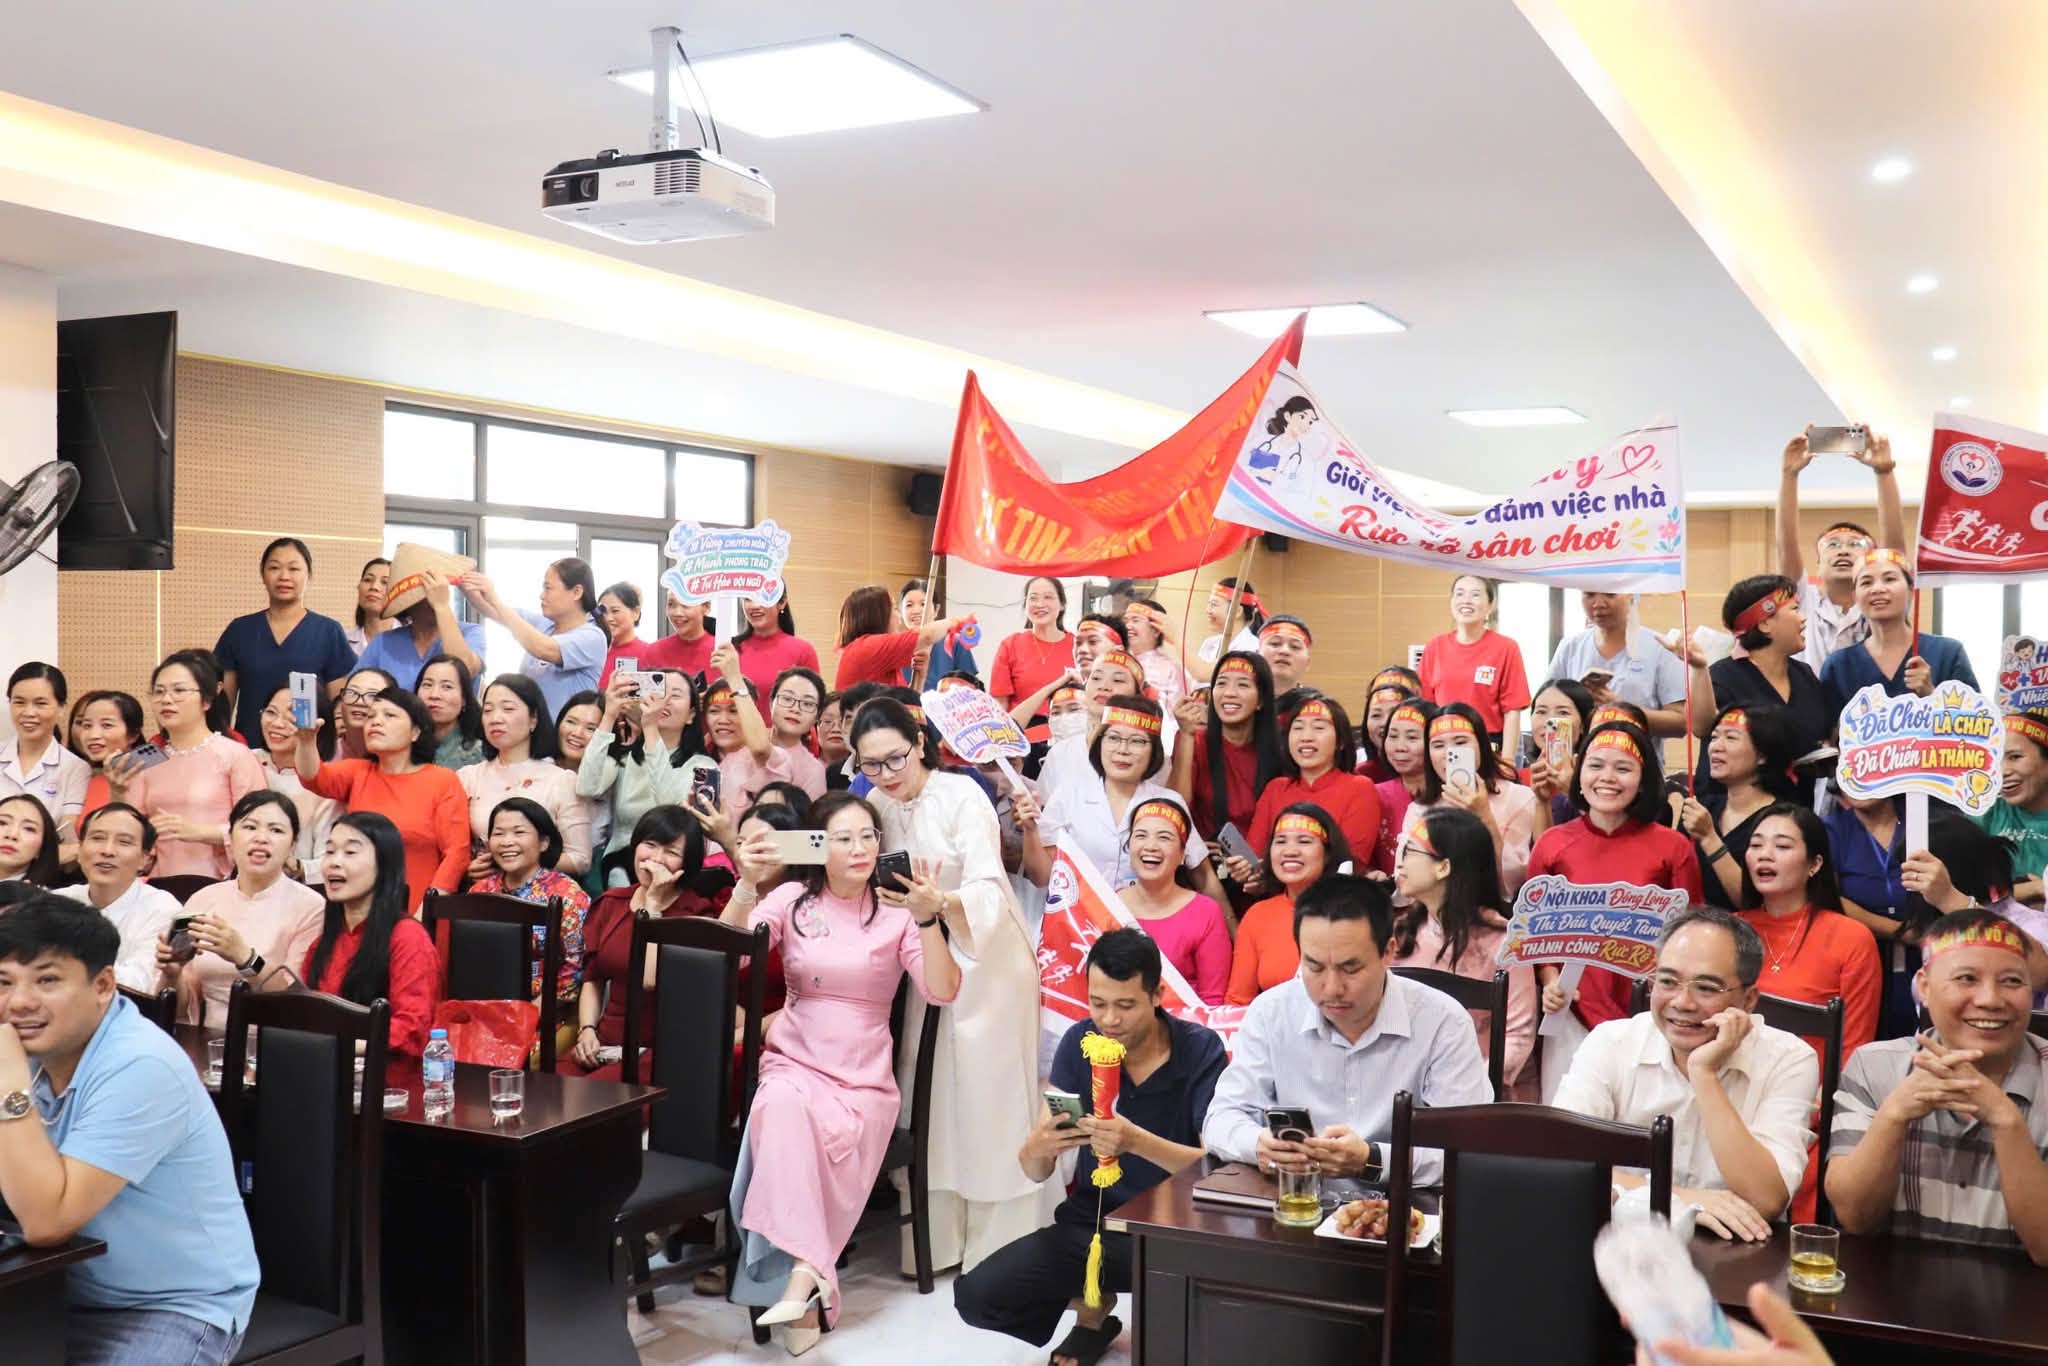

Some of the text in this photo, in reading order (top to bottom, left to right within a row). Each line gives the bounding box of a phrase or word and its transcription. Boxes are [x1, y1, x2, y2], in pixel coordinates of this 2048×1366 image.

[1551, 490, 1607, 519] việc
[1613, 483, 1667, 511] nhà
[1338, 504, 1410, 545] Rực
[1466, 530, 1537, 559] sân
[1543, 520, 1621, 555] chơi
[2018, 687, 2048, 706] Nhiệ
[1933, 710, 1953, 736] LÀ
[1953, 708, 1994, 738] CHẤT
[1854, 738, 1985, 778] Đã Chiến LÀ THẮNG
[1544, 888, 1569, 909] NỘI
[1569, 890, 1607, 906] KHOA
[1534, 914, 1557, 933] Thi
[1558, 912, 1588, 931] Đấu
[1590, 913, 1633, 937] Quyết
[1521, 938, 1564, 956] THÀNH
[1565, 937, 1600, 955] CÔNG
